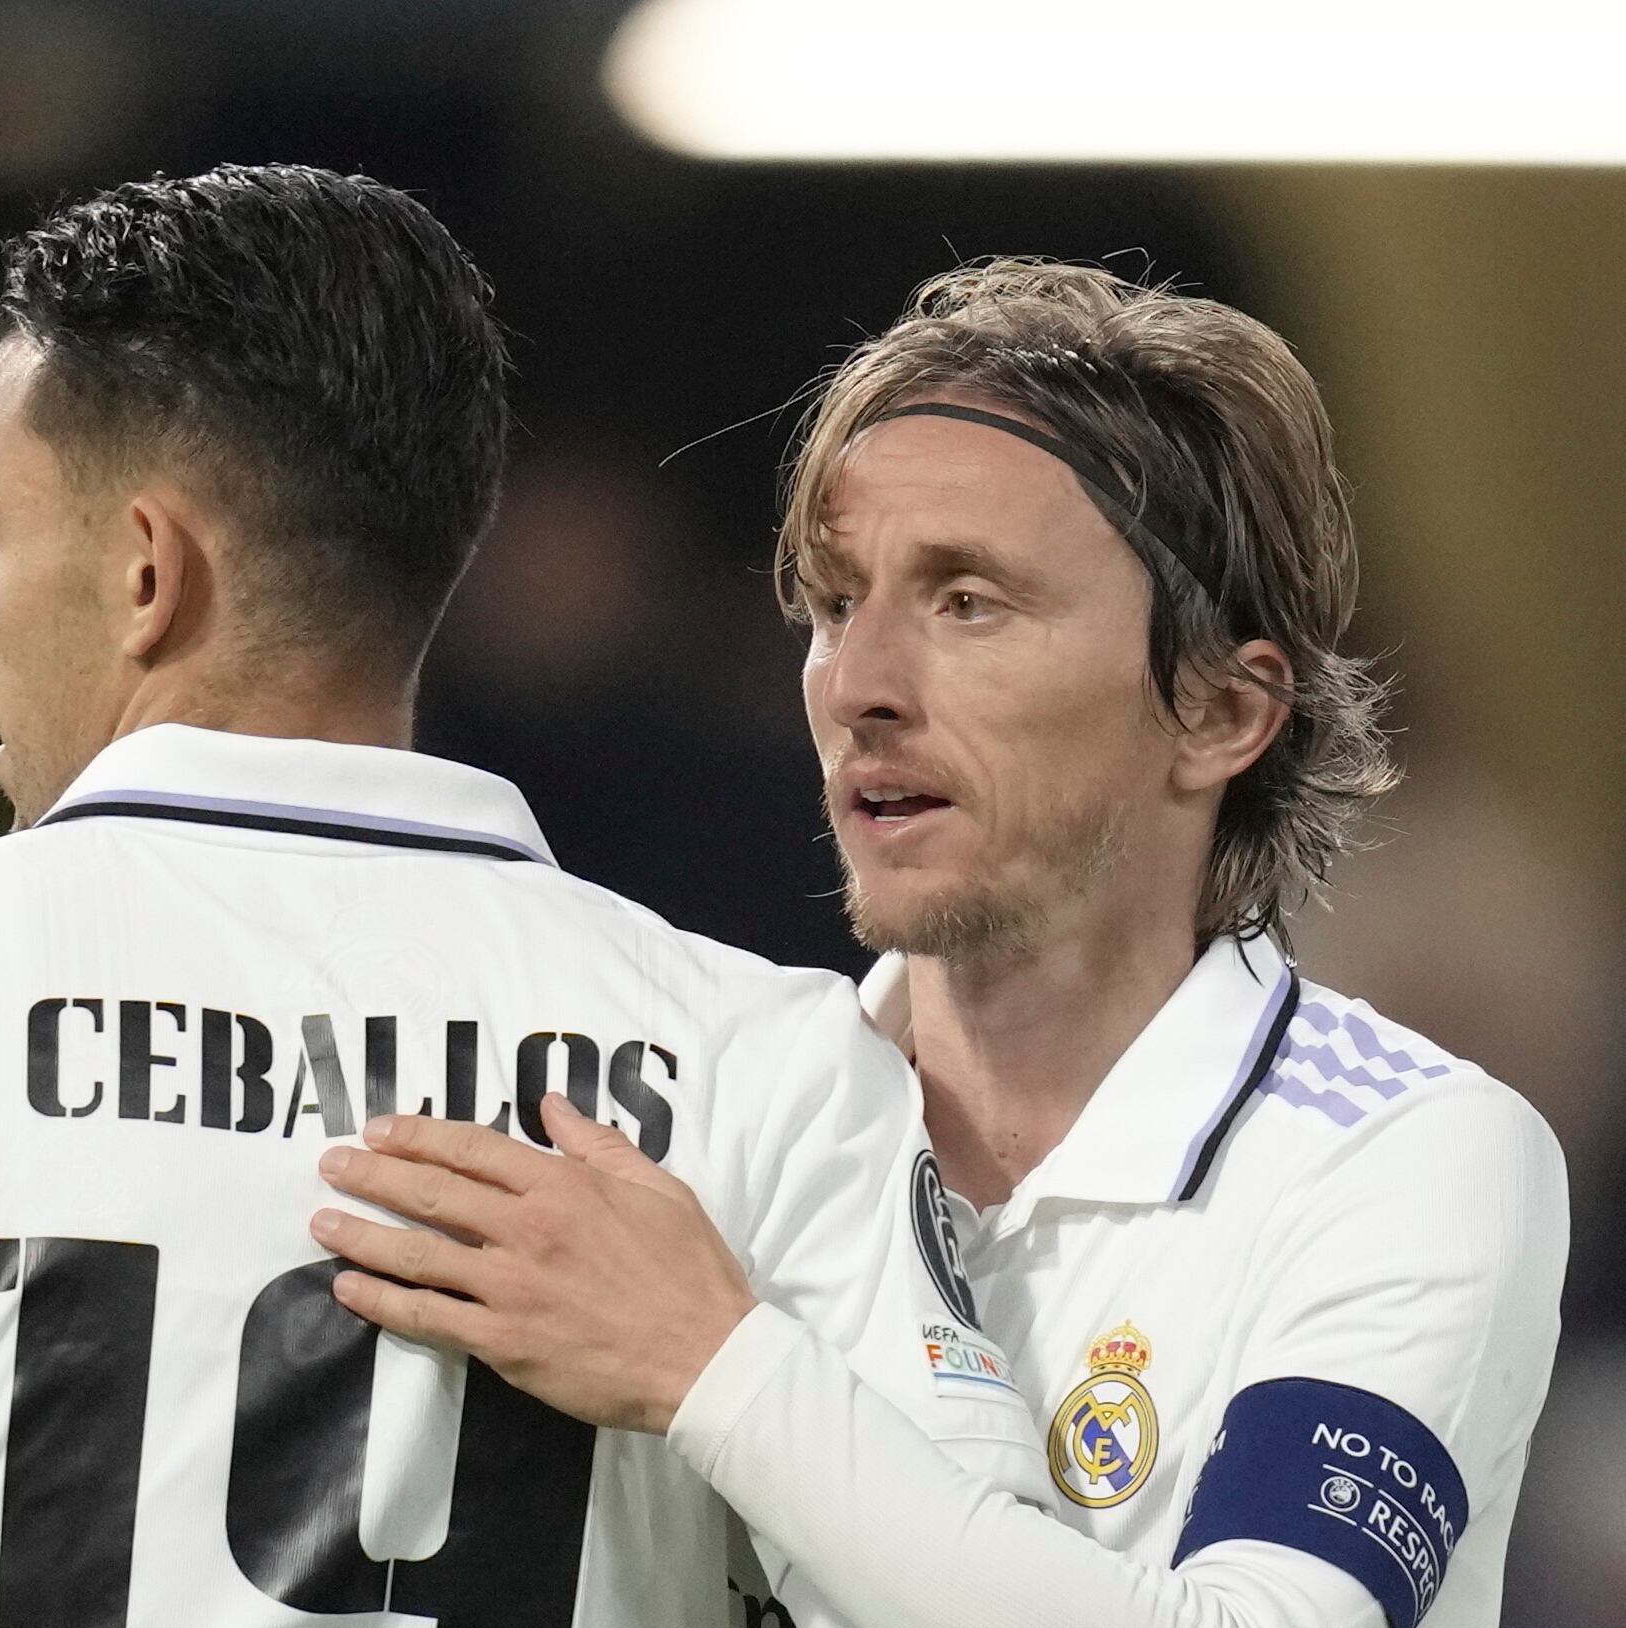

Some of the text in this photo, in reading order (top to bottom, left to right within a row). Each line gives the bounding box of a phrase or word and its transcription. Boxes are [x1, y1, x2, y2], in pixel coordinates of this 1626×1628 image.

[27, 997, 678, 1165] CEBALLOS
[923, 1323, 960, 1343] UEFA
[1312, 1423, 1371, 1457] NO
[1379, 1445, 1418, 1488] TO
